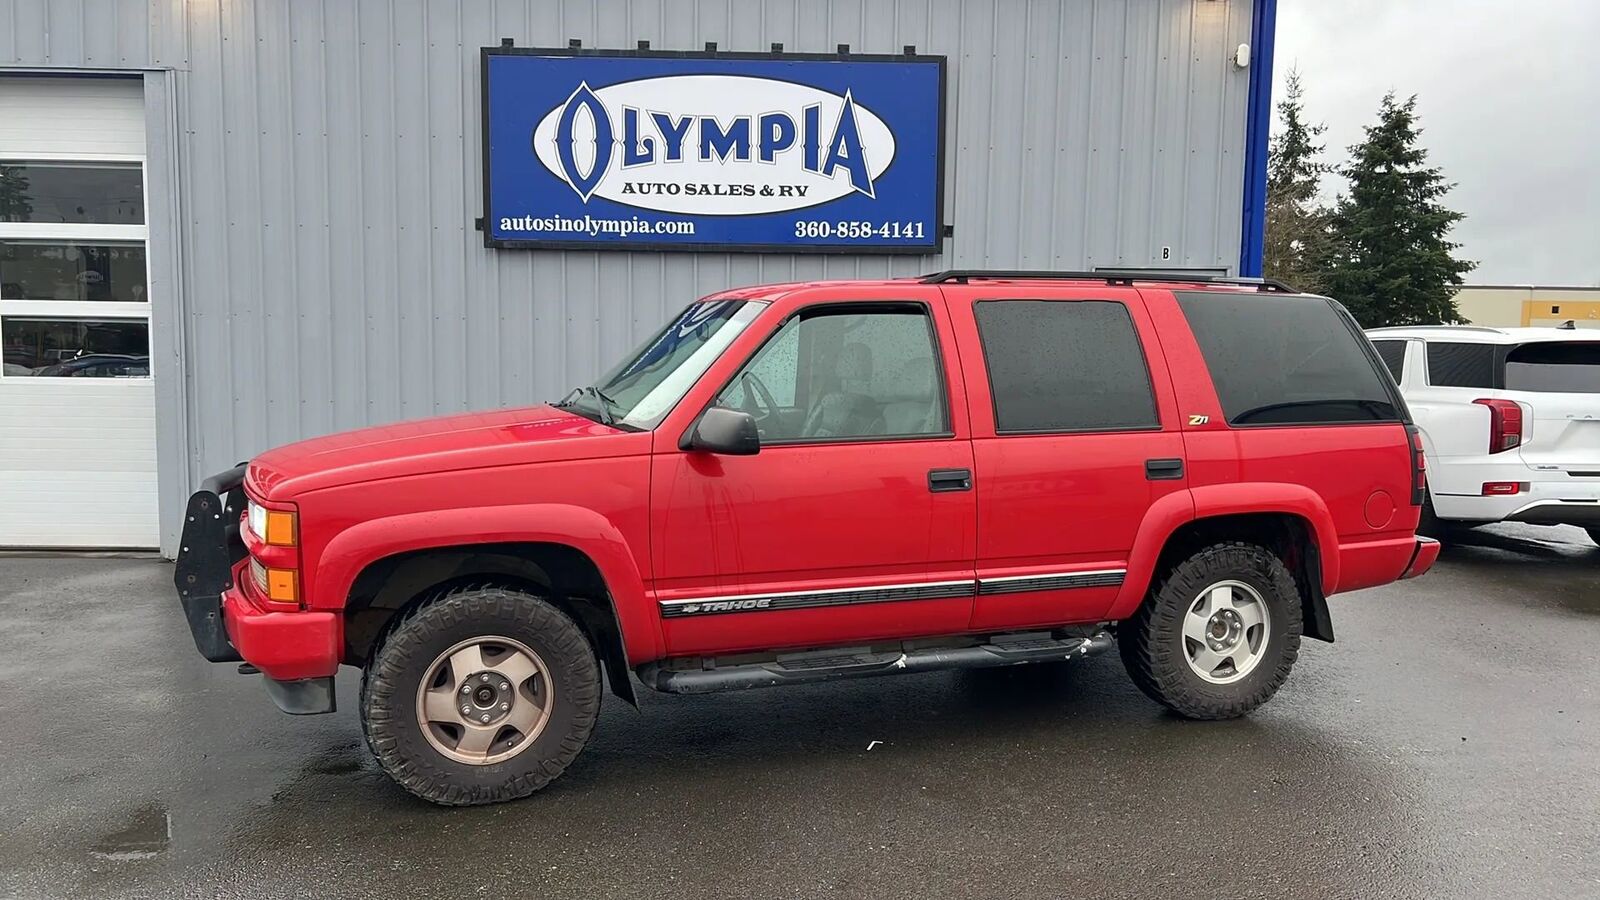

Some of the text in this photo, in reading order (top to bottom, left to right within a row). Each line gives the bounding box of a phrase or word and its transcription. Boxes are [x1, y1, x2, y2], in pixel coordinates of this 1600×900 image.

[554, 80, 876, 204] OLYMPIA
[621, 182, 810, 197] AUTO SALES & RV
[500, 214, 696, 237] autosinolympia.com
[794, 220, 925, 239] 360-858-4141
[1162, 247, 1170, 260] B
[702, 599, 772, 613] TAHOE
